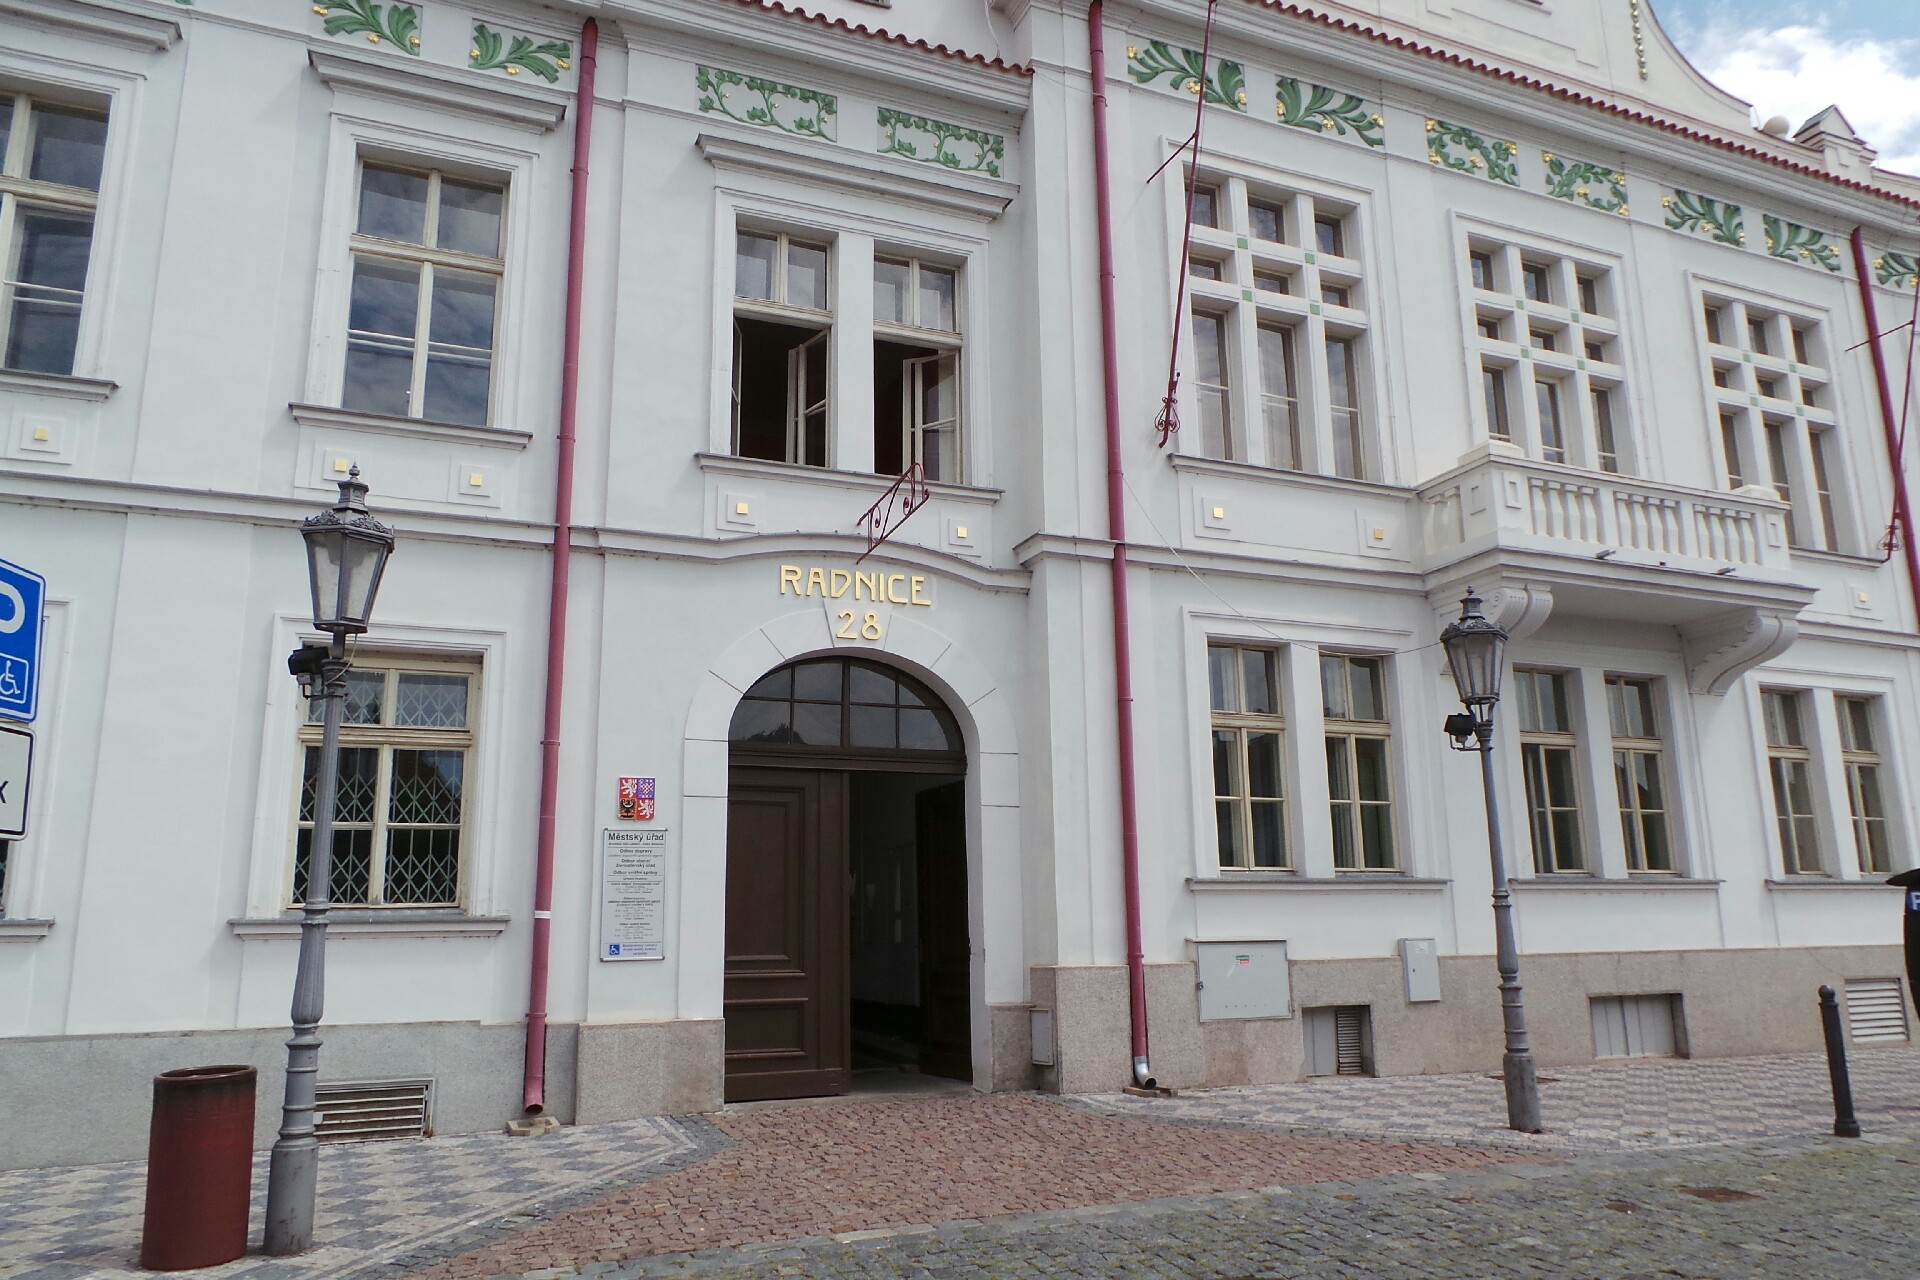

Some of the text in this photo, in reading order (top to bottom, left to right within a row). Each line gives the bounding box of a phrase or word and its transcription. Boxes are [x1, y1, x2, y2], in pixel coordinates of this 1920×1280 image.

[780, 564, 932, 606] RADNICE
[836, 608, 882, 640] 28
[608, 832, 664, 842] Městský úřad
